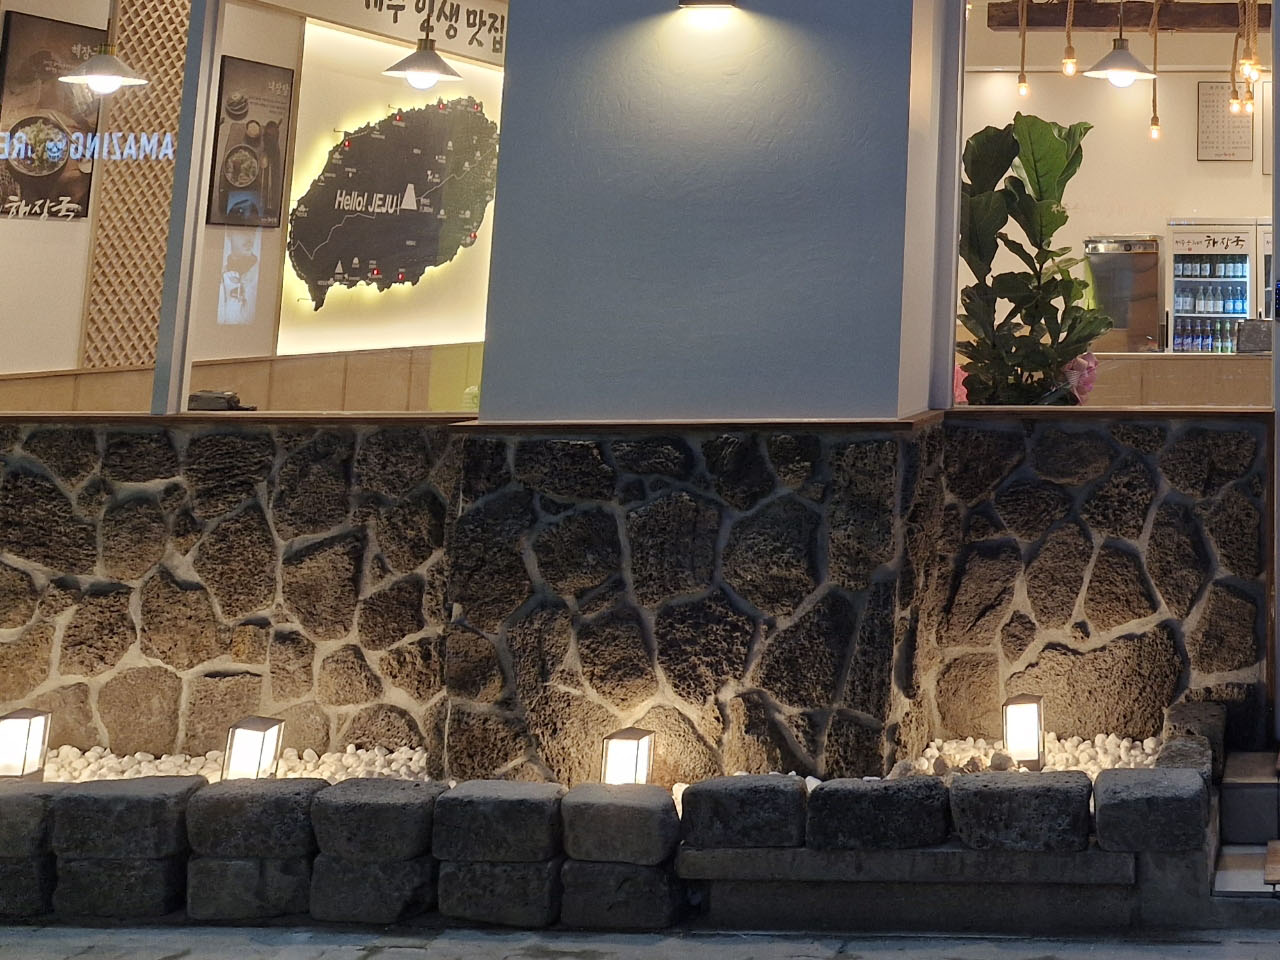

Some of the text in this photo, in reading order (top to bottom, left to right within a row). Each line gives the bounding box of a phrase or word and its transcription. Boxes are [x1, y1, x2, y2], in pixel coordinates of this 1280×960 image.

[466, 8, 505, 53] 맛집
[72, 44, 100, 58] 해장
[335, 190, 367, 211] Hello!
[368, 193, 398, 214] JEJU
